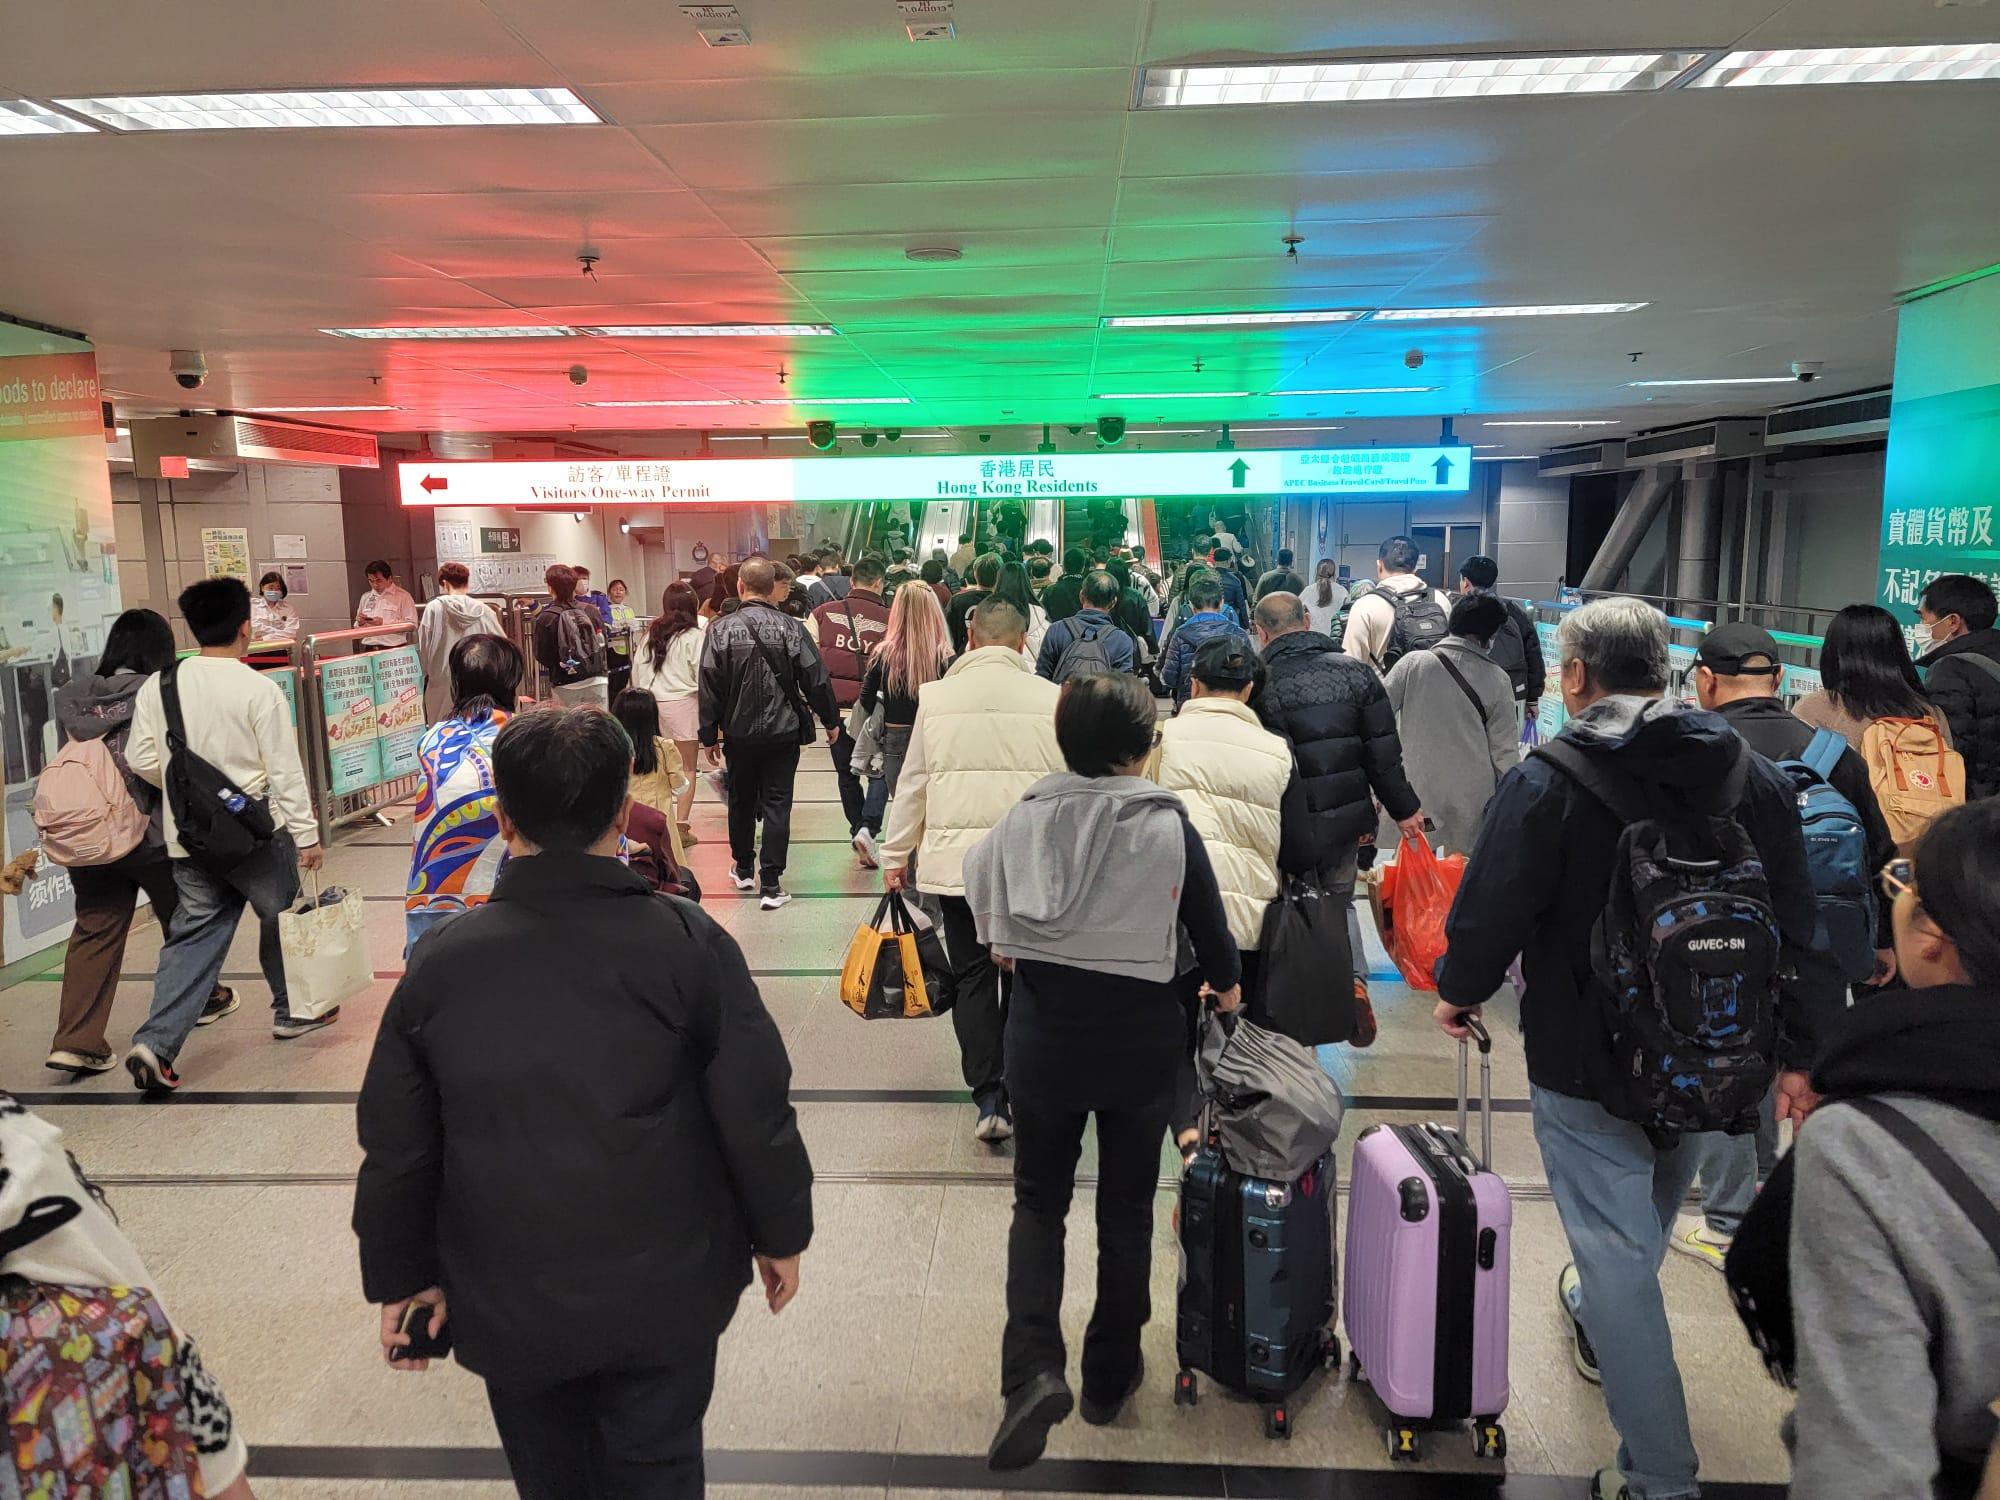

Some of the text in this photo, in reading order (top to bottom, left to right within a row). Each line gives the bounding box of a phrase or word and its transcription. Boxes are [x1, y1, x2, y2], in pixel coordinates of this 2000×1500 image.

[32, 379, 46, 402] to
[49, 373, 97, 401] declare
[567, 464, 672, 483] 訪客/單程證
[980, 459, 1055, 478] 香港居民
[530, 484, 711, 501] Visitors/One-way Permit
[937, 479, 1098, 496] Hong Kong Residents
[1284, 479, 1306, 487] APEC
[1887, 505, 1993, 546] 實體貨幣及
[835, 633, 874, 654] BOY
